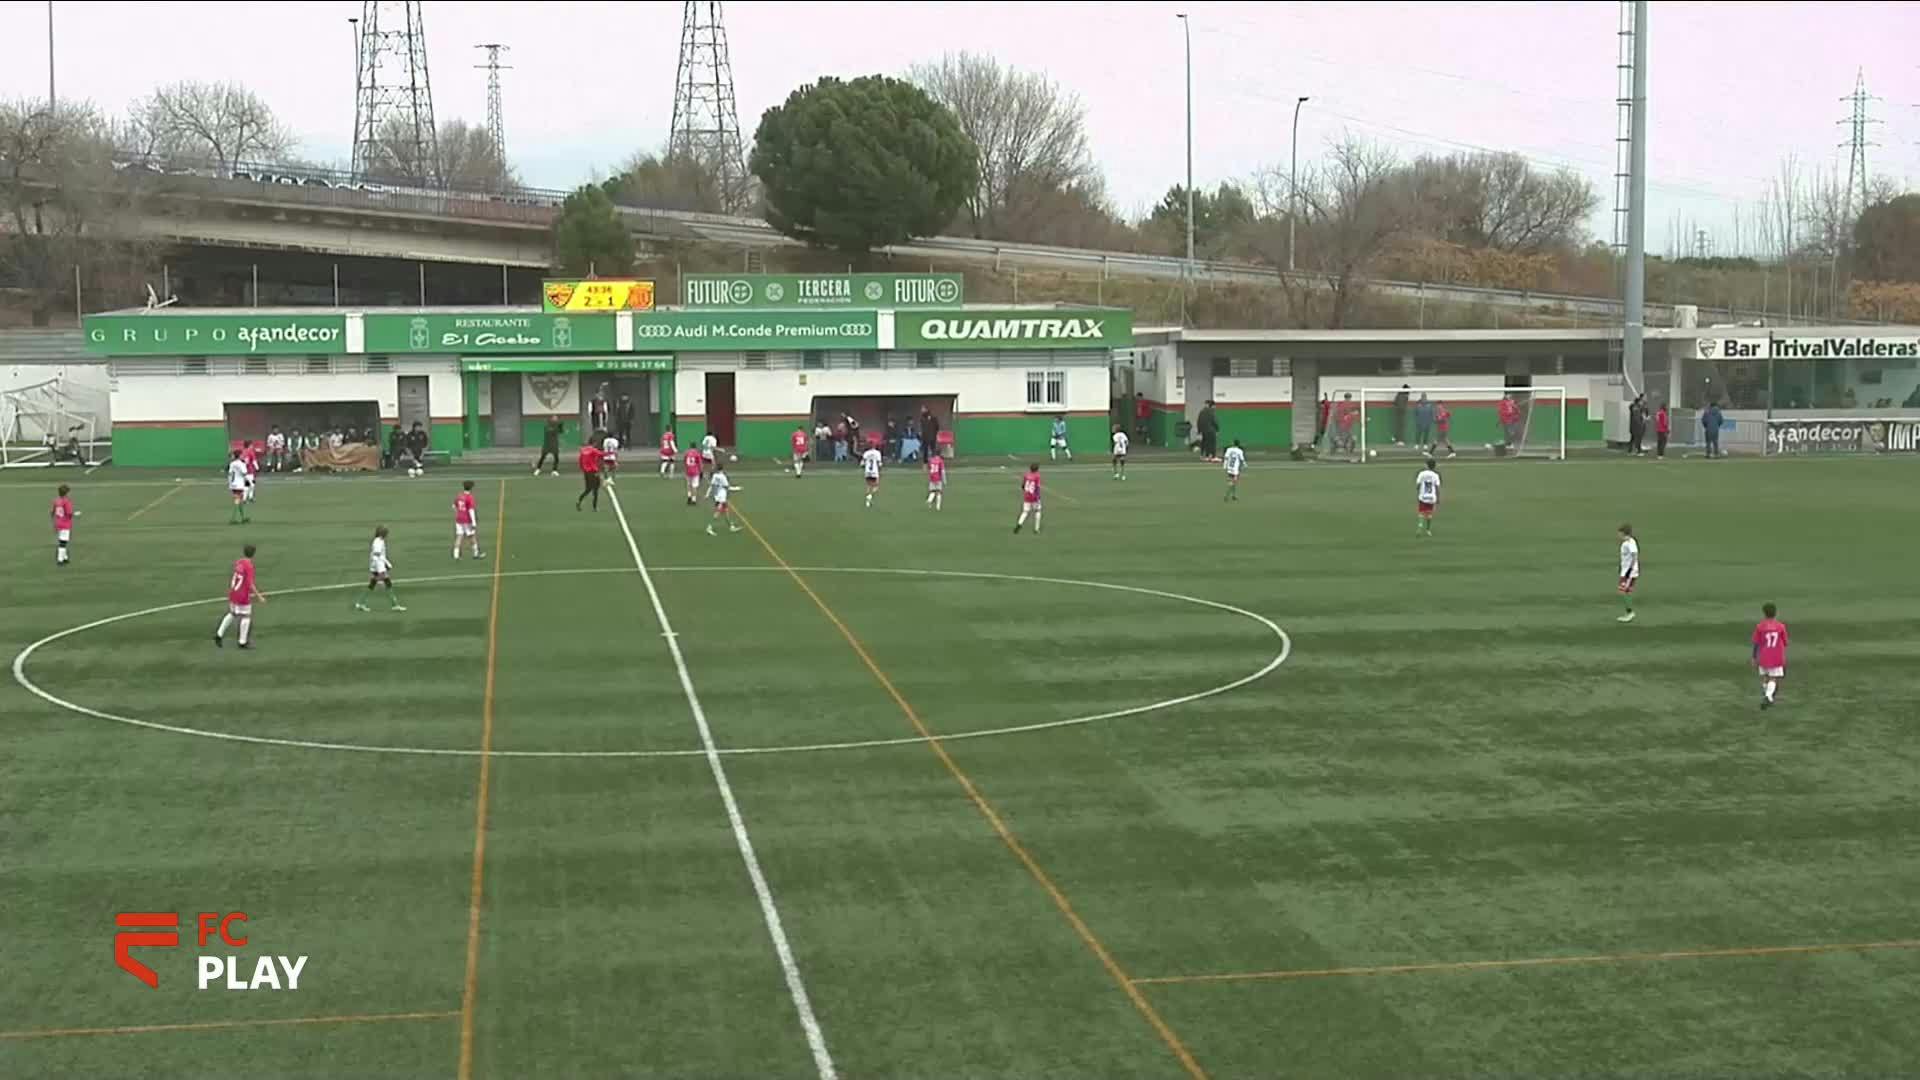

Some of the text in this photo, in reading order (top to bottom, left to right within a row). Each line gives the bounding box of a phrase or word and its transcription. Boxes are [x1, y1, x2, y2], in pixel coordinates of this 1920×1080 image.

[798, 280, 850, 297] TERCERA
[584, 296, 591, 307] 2
[455, 318, 530, 328] RESTAURANTE
[674, 323, 838, 337] Audi M.Conde Premium
[920, 319, 1105, 339] QUAMTRAX
[91, 323, 339, 351] GRUPO afandecor
[442, 333, 469, 345] El
[1724, 340, 1761, 357] Bar
[1768, 423, 1861, 453] afandecor
[1765, 632, 1778, 648] 17
